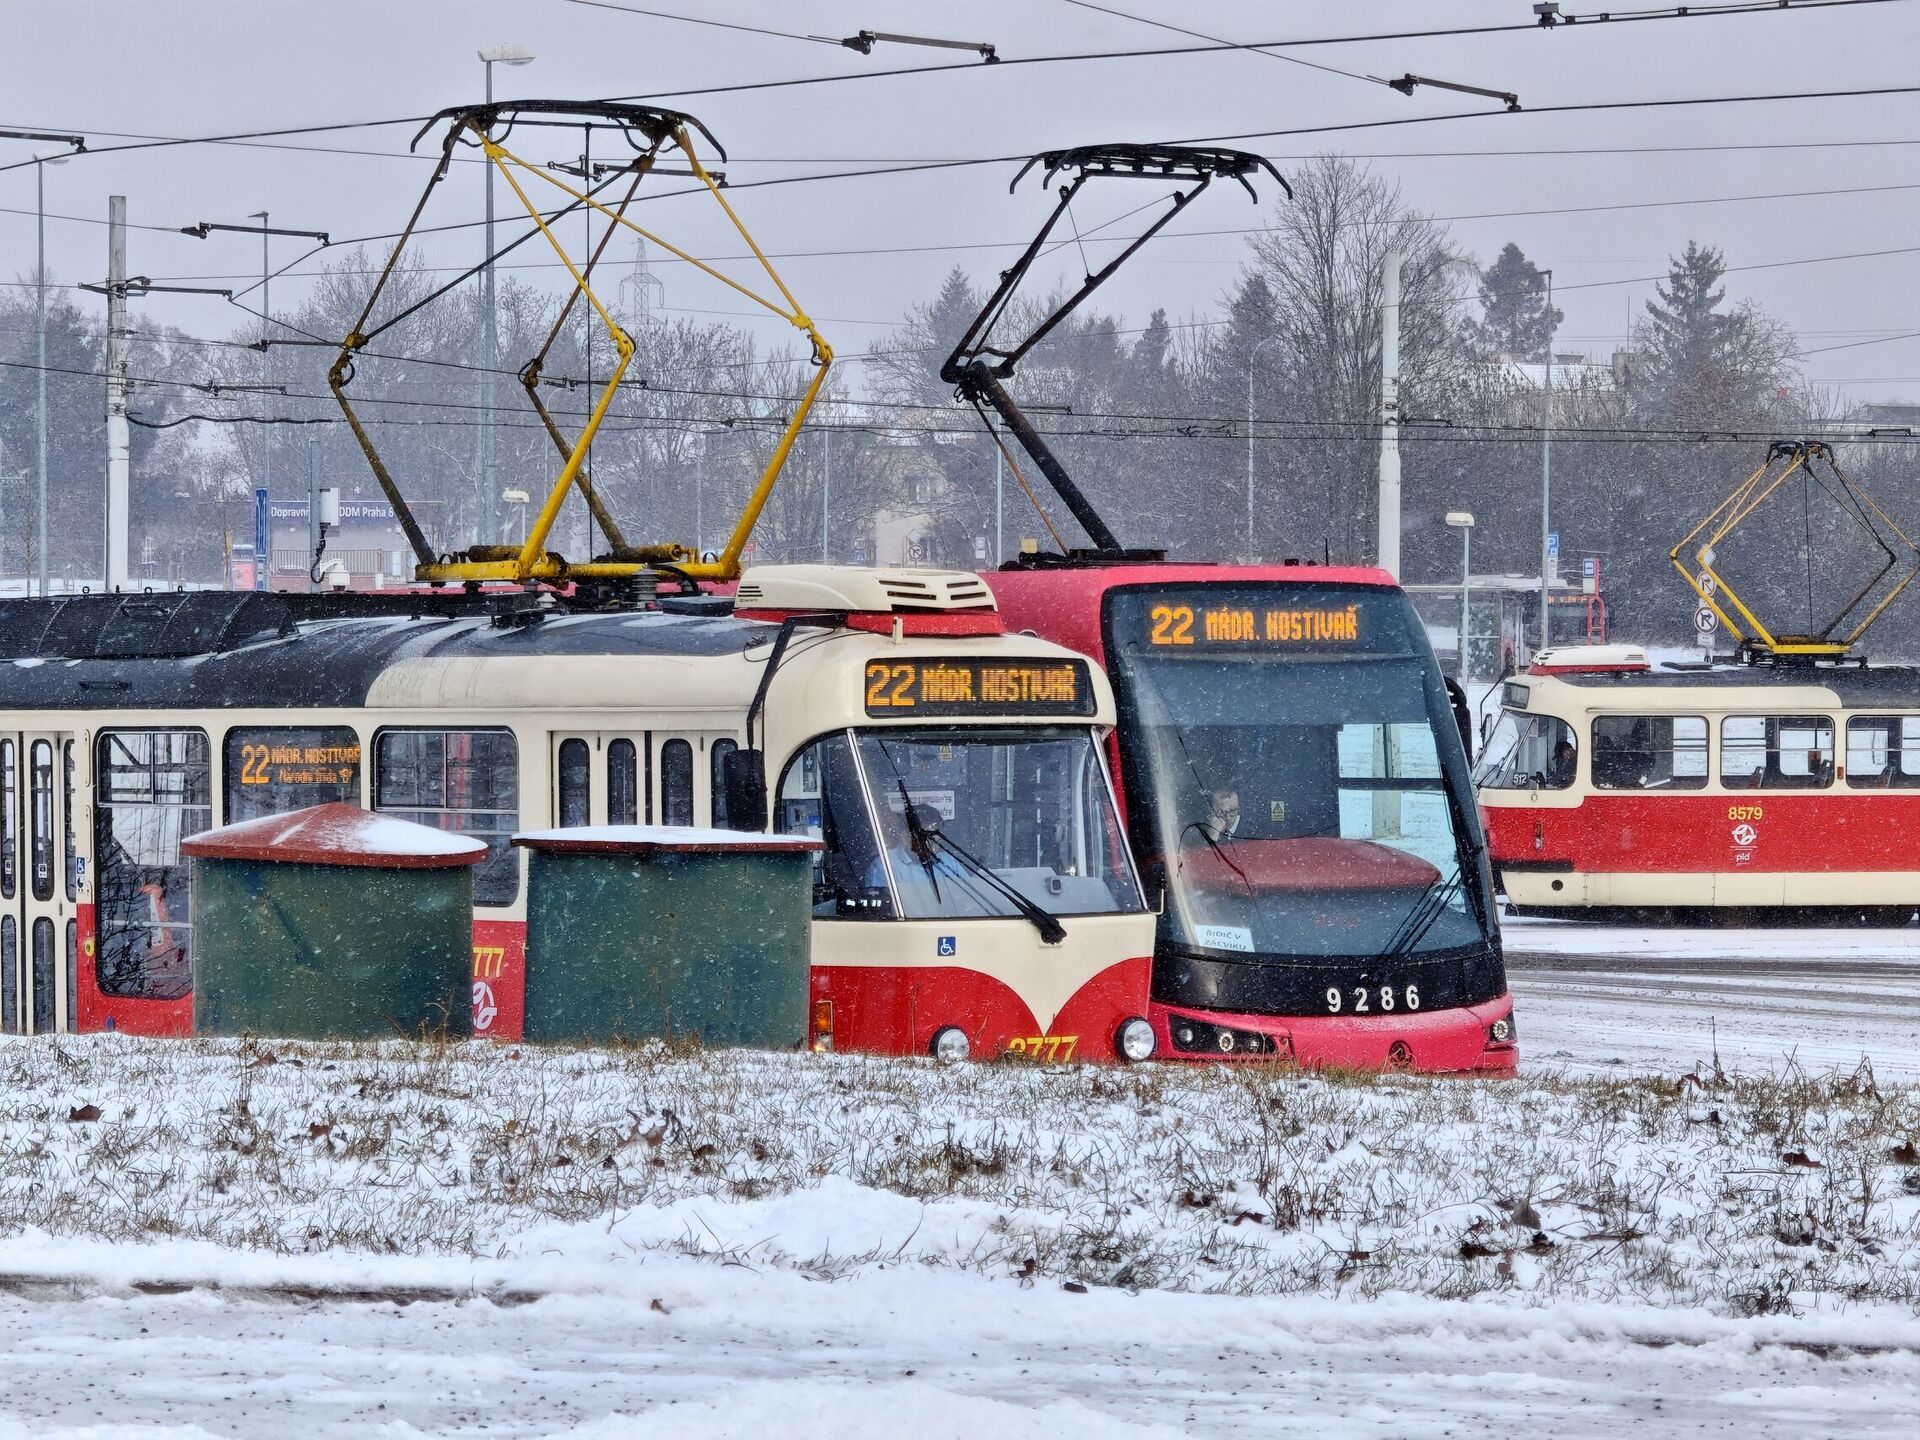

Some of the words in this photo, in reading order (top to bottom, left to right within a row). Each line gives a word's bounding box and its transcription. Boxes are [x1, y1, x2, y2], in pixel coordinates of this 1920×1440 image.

[340, 506, 361, 517] DDM
[362, 506, 386, 517] Praha
[1151, 606, 1194, 645] 22
[1206, 605, 1260, 641] NÁDR.
[1266, 604, 1357, 641] HOSTIVAŘ
[866, 665, 915, 706] 22
[921, 663, 977, 702] NÁDR.
[981, 664, 1076, 702] HOSTIVAŘ
[241, 745, 270, 784] 22
[1513, 774, 1527, 784] 512
[1728, 806, 1763, 820] 8579
[1326, 985, 1420, 1013] 9286
